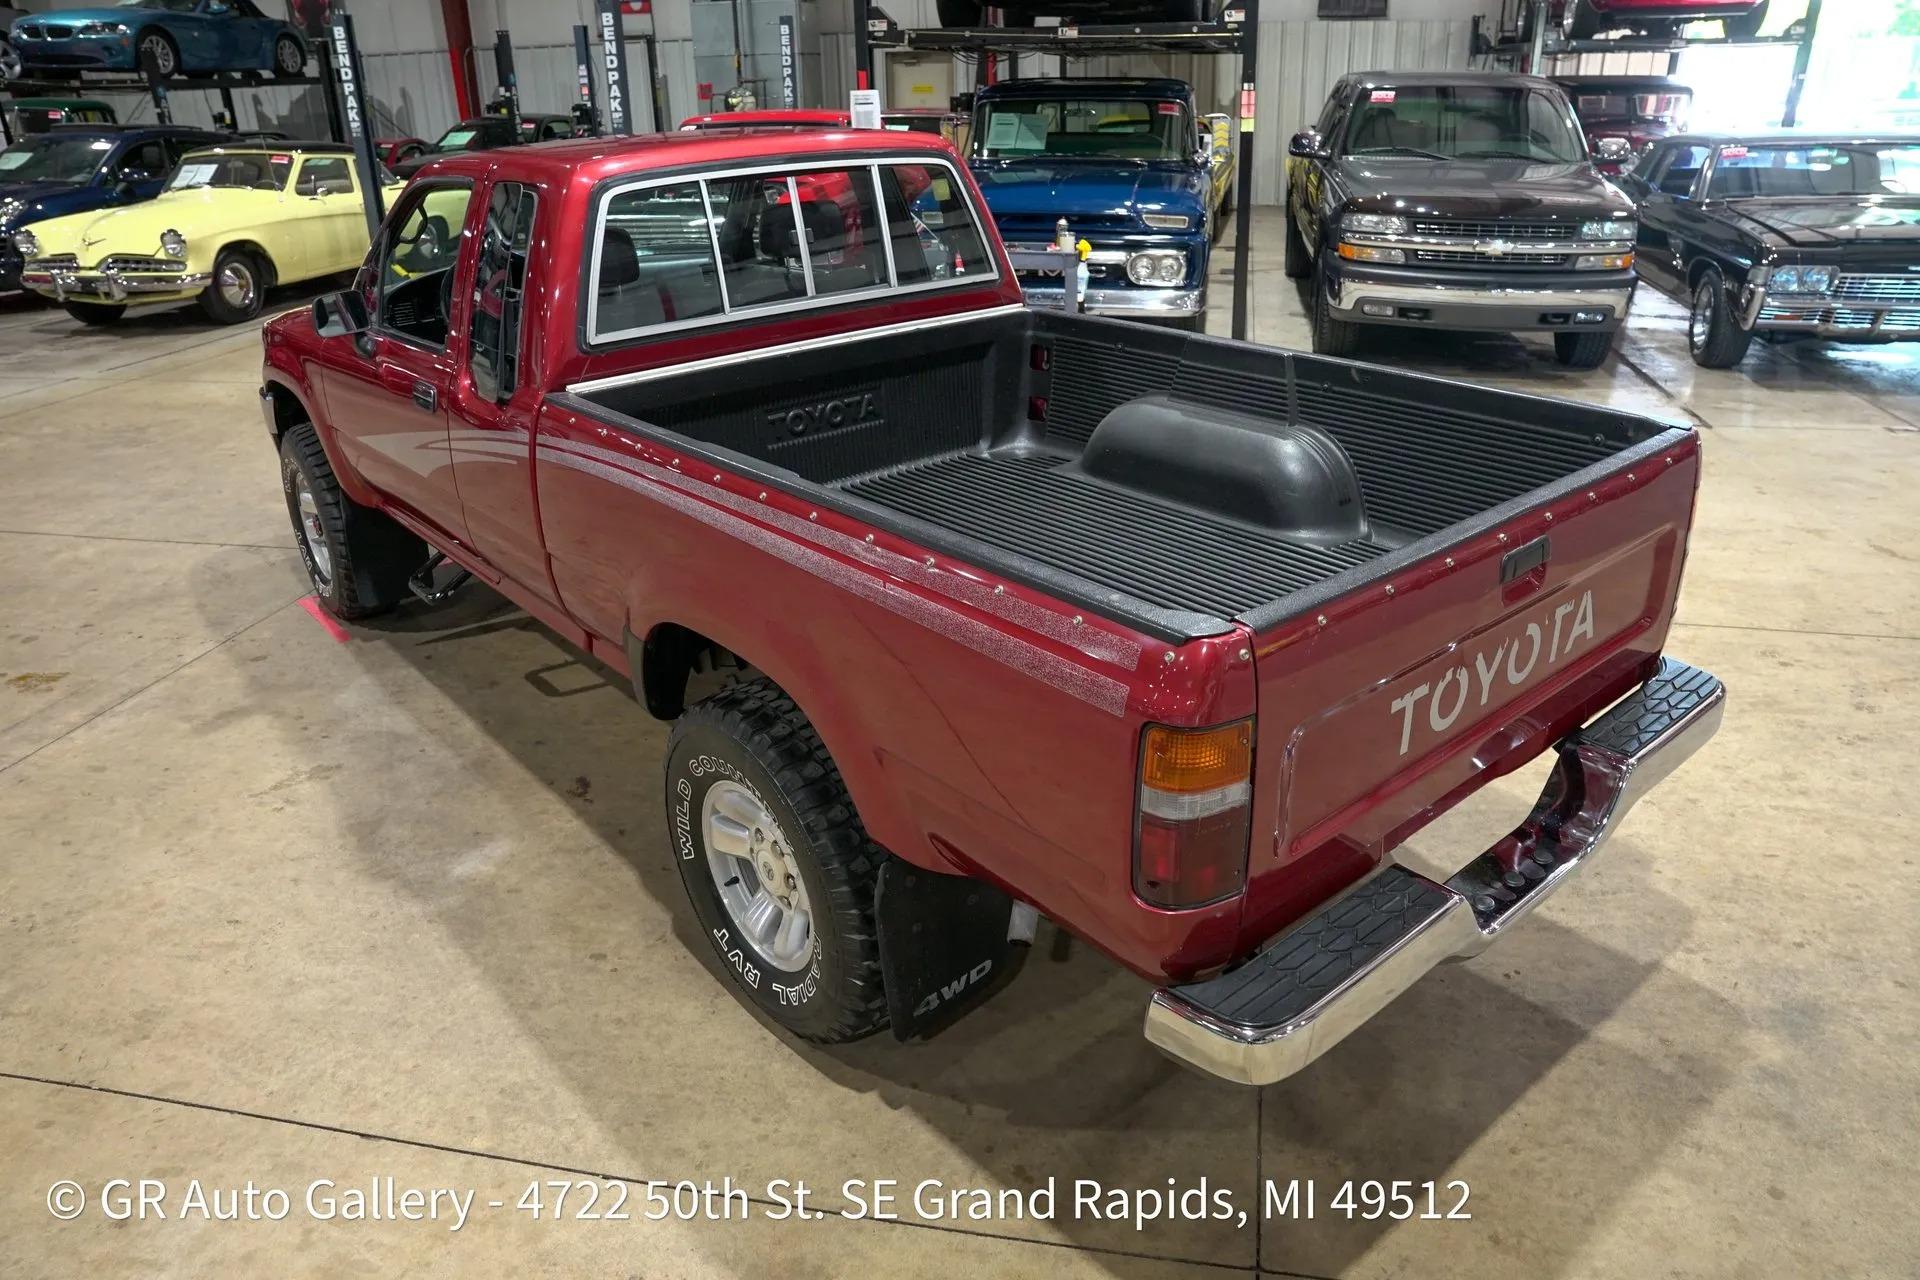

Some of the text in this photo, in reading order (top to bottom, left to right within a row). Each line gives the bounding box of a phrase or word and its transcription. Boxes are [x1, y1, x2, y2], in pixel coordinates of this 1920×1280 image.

[333, 26, 359, 121] BENDPAK
[601, 12, 622, 112] BENDPAK
[780, 25, 793, 97] BENDPAK
[767, 393, 877, 437] TOYOTA
[1391, 589, 1594, 756] TOYOTA
[676, 779, 695, 860] WILD
[713, 928, 761, 989] RVT
[912, 958, 993, 1017] 4WD
